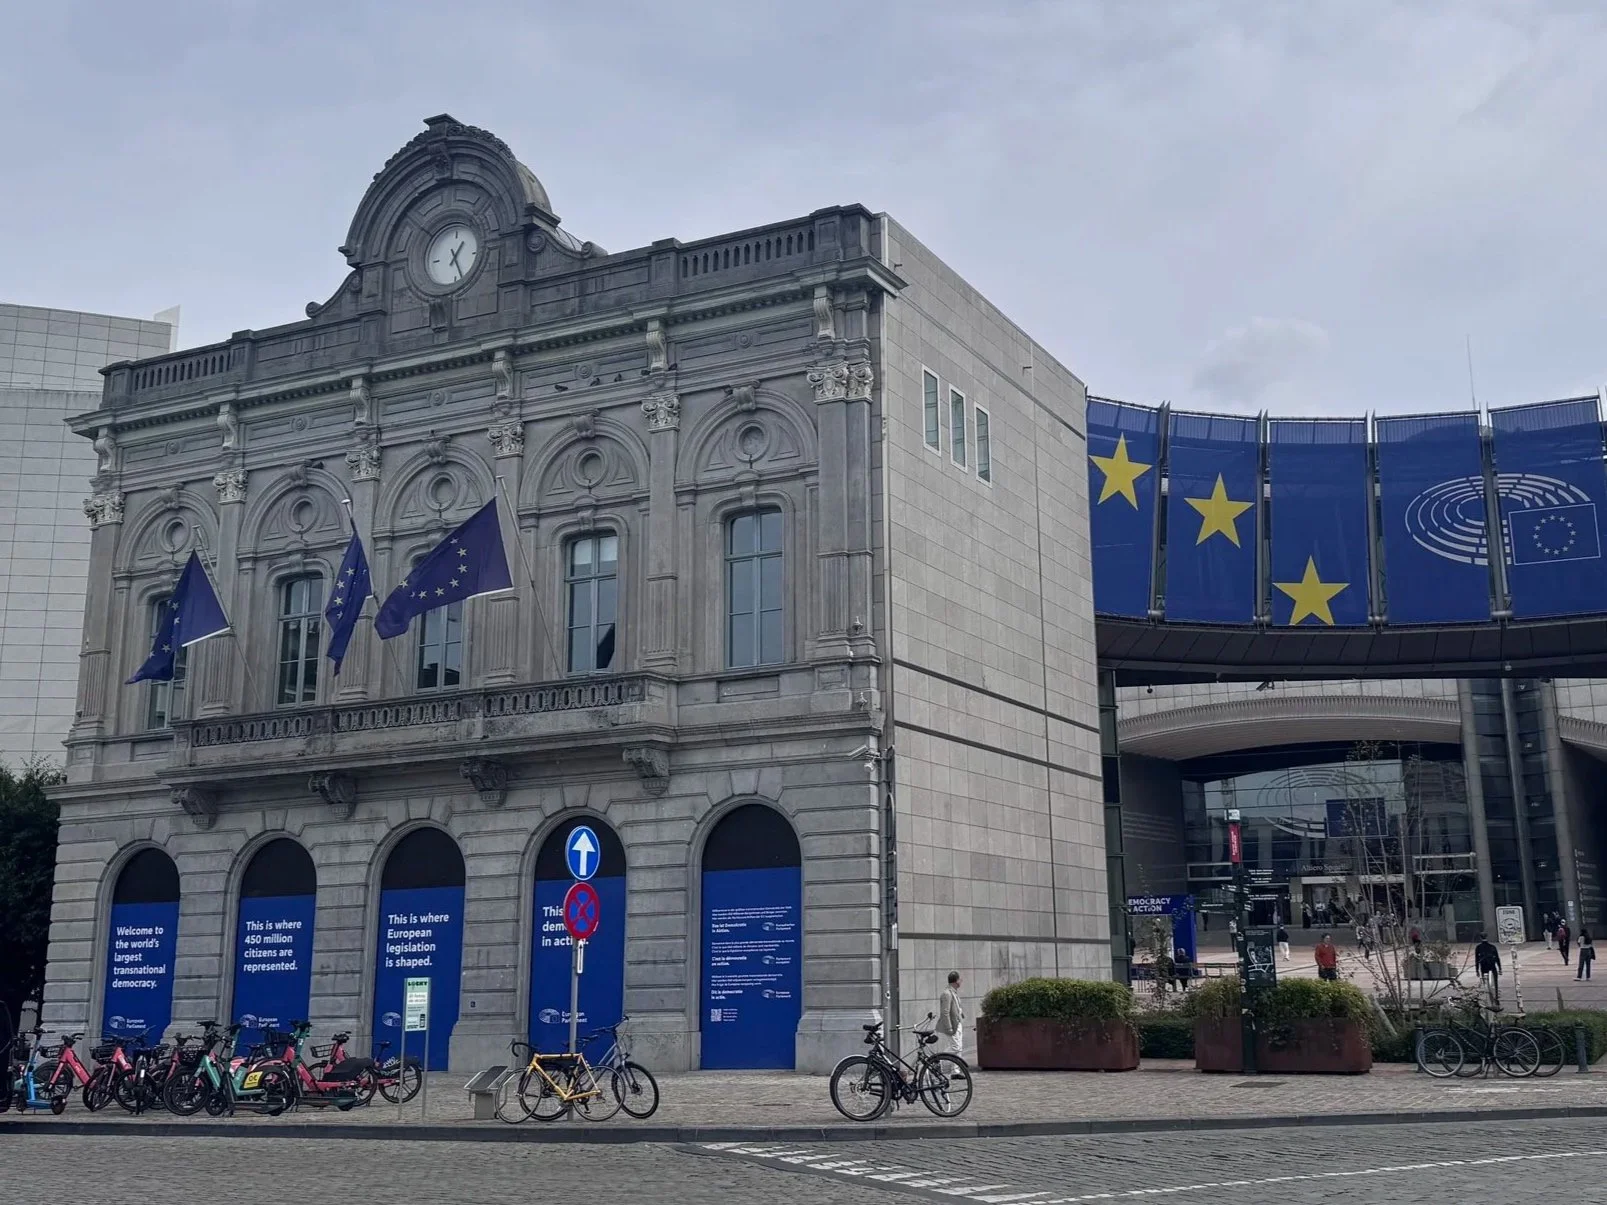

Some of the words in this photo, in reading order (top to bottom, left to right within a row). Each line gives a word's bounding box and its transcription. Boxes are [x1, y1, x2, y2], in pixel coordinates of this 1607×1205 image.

[1128, 897, 1171, 905] EMOCRACY
[542, 906, 564, 917] This
[388, 914, 408, 925] This
[409, 913, 418, 924] is
[420, 912, 449, 923] where
[246, 921, 264, 931] This
[265, 920, 273, 930] is
[275, 919, 302, 930] where
[116, 926, 153, 936] Welcome
[155, 926, 164, 935] to
[387, 928, 432, 940] European
[115, 939, 129, 949] the
[130, 938, 160, 948] world's
[244, 935, 261, 944] 450
[263, 933, 293, 943] million
[542, 936, 551, 947] in
[243, 948, 277, 958] citizens
[279, 948, 293, 957] are
[386, 941, 436, 955] legislation
[114, 952, 142, 964] largest
[385, 957, 394, 968] is
[395, 955, 433, 968] shaped.
[113, 964, 166, 975] transnational
[243, 960, 298, 973] represented.
[112, 978, 157, 989] democracy.
